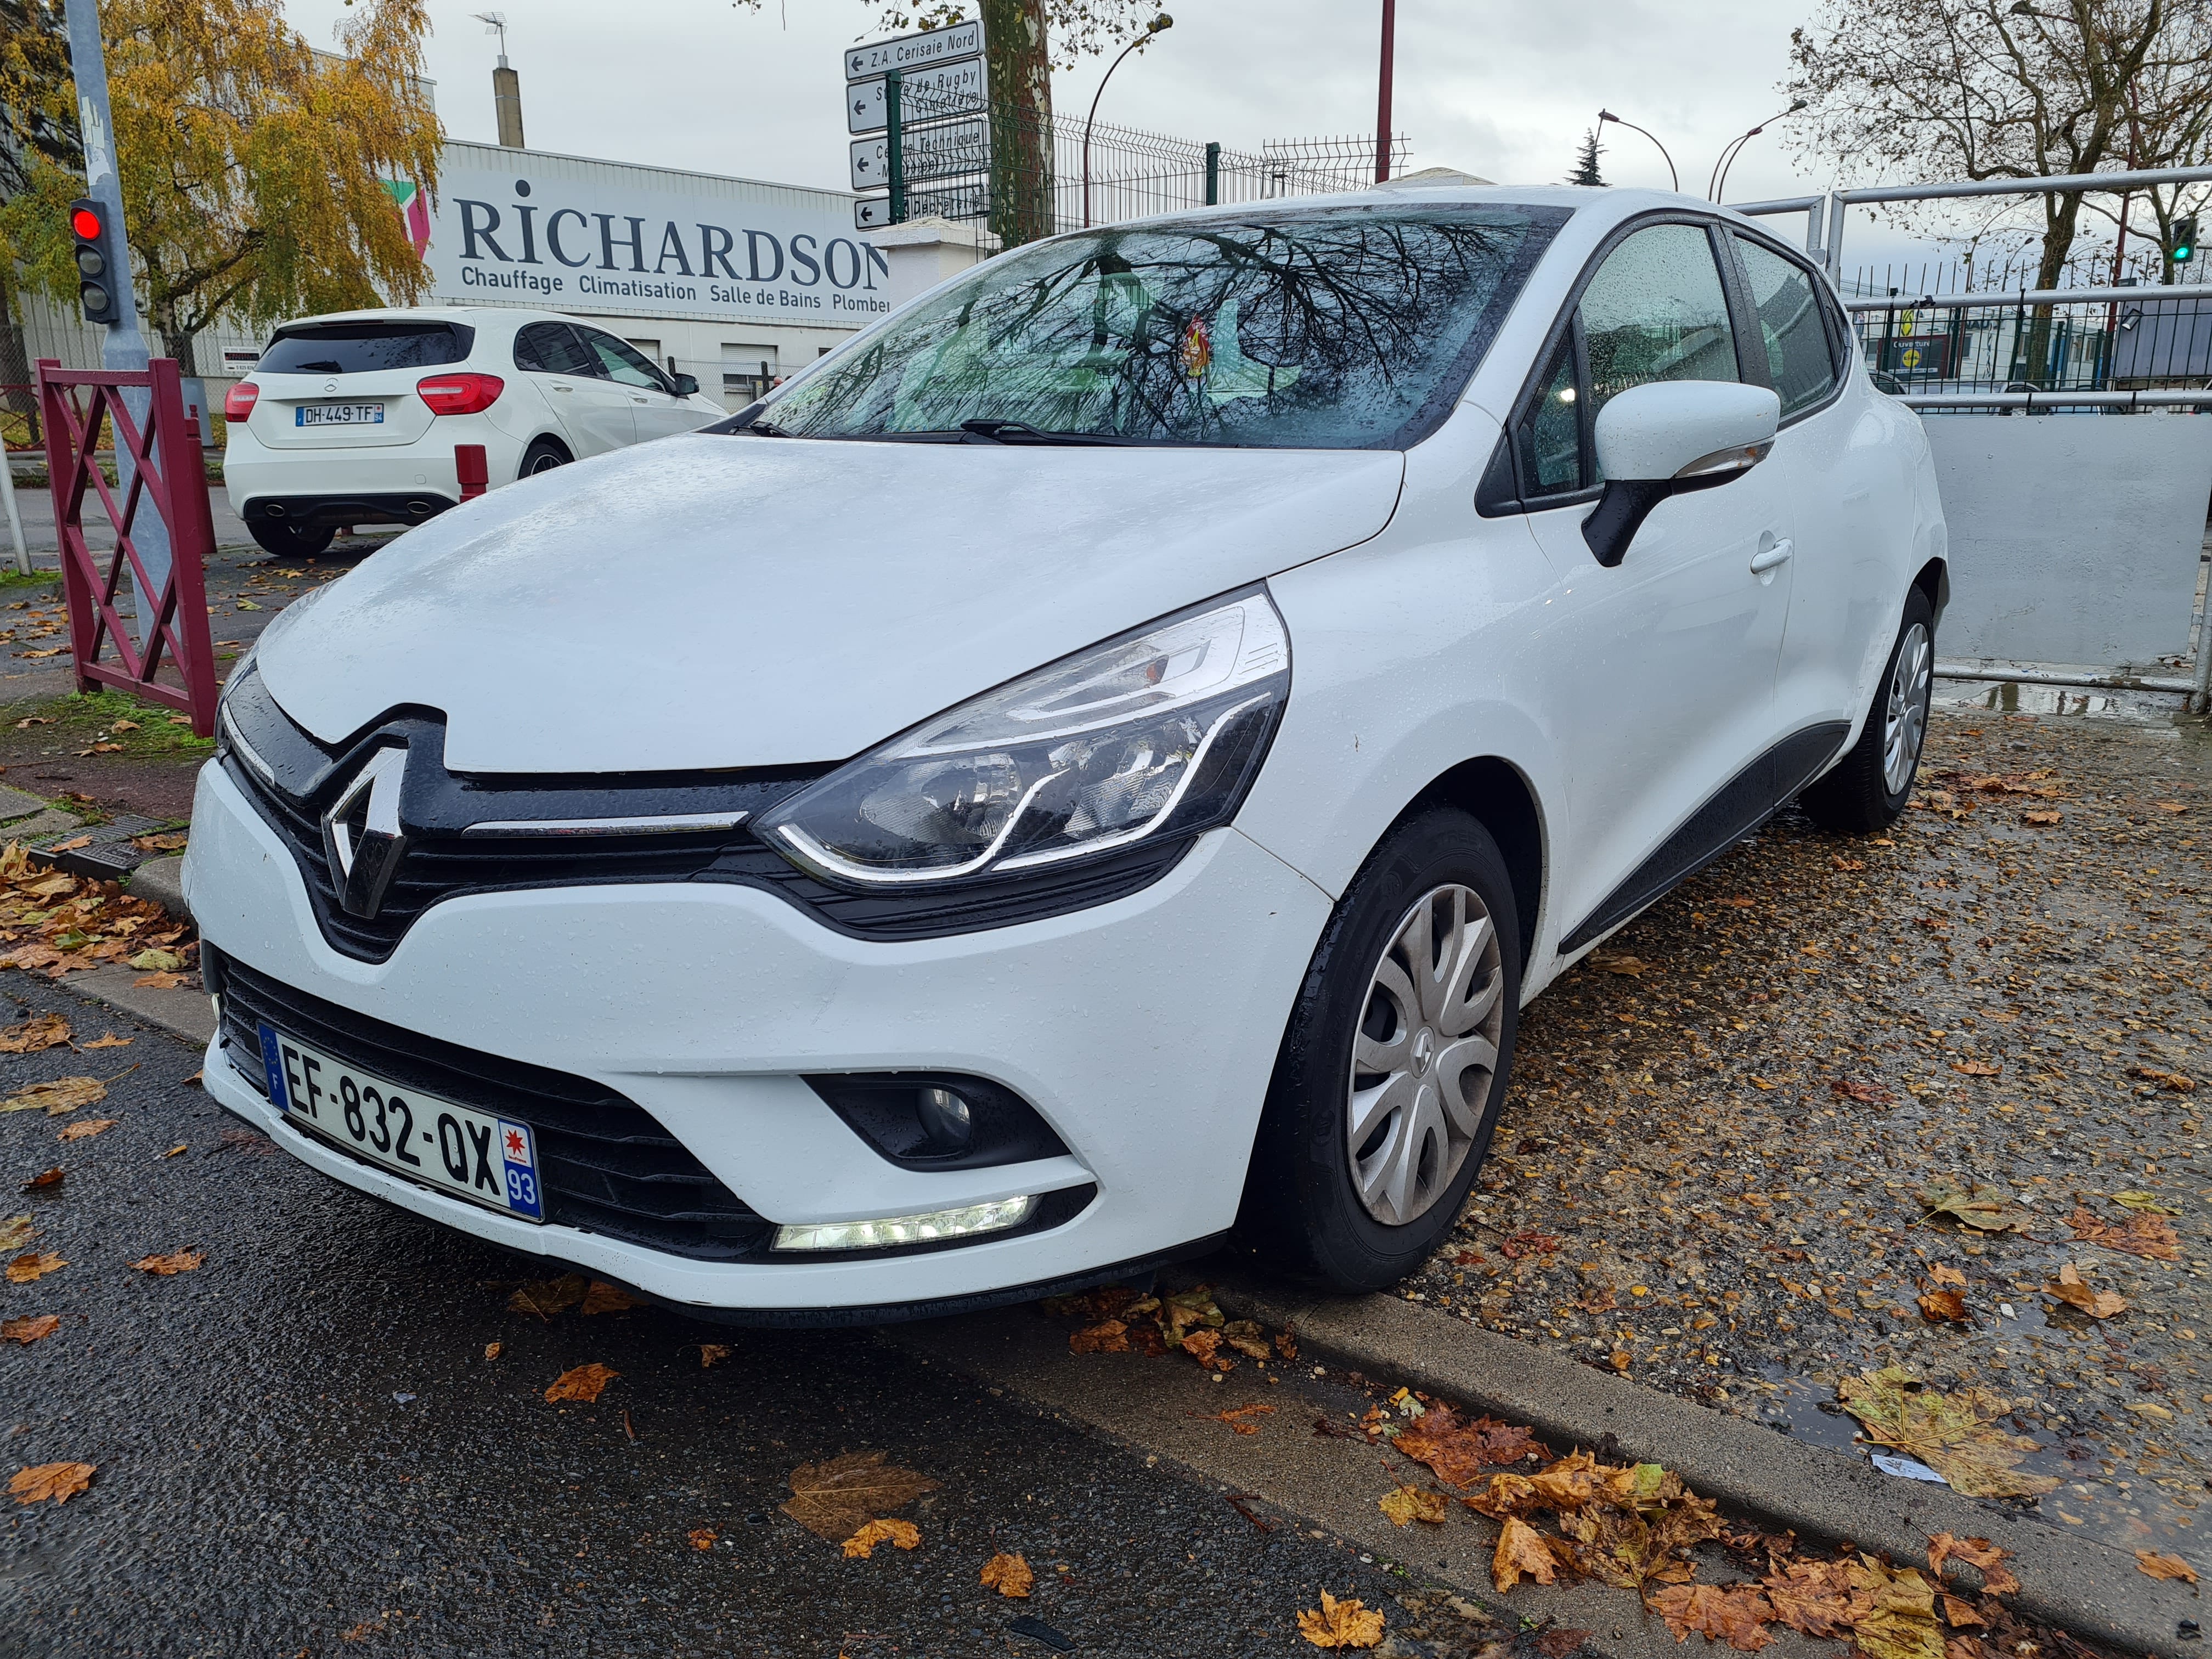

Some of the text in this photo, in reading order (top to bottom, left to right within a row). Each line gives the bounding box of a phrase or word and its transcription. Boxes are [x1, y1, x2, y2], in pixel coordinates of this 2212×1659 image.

[871, 30, 974, 67] Z.A. Cerisaie Nord
[938, 69, 976, 88] Rugby
[920, 132, 979, 152] Technique
[462, 266, 563, 295] Chauffage
[579, 275, 697, 301] Climatisation
[710, 285, 752, 305] Salle
[757, 287, 775, 306] de
[780, 290, 821, 308] Bains
[306, 406, 373, 424] DH-449-TF
[272, 1073, 278, 1090] F
[282, 1043, 500, 1197] EF-832-QX
[506, 1169, 536, 1205] 93
